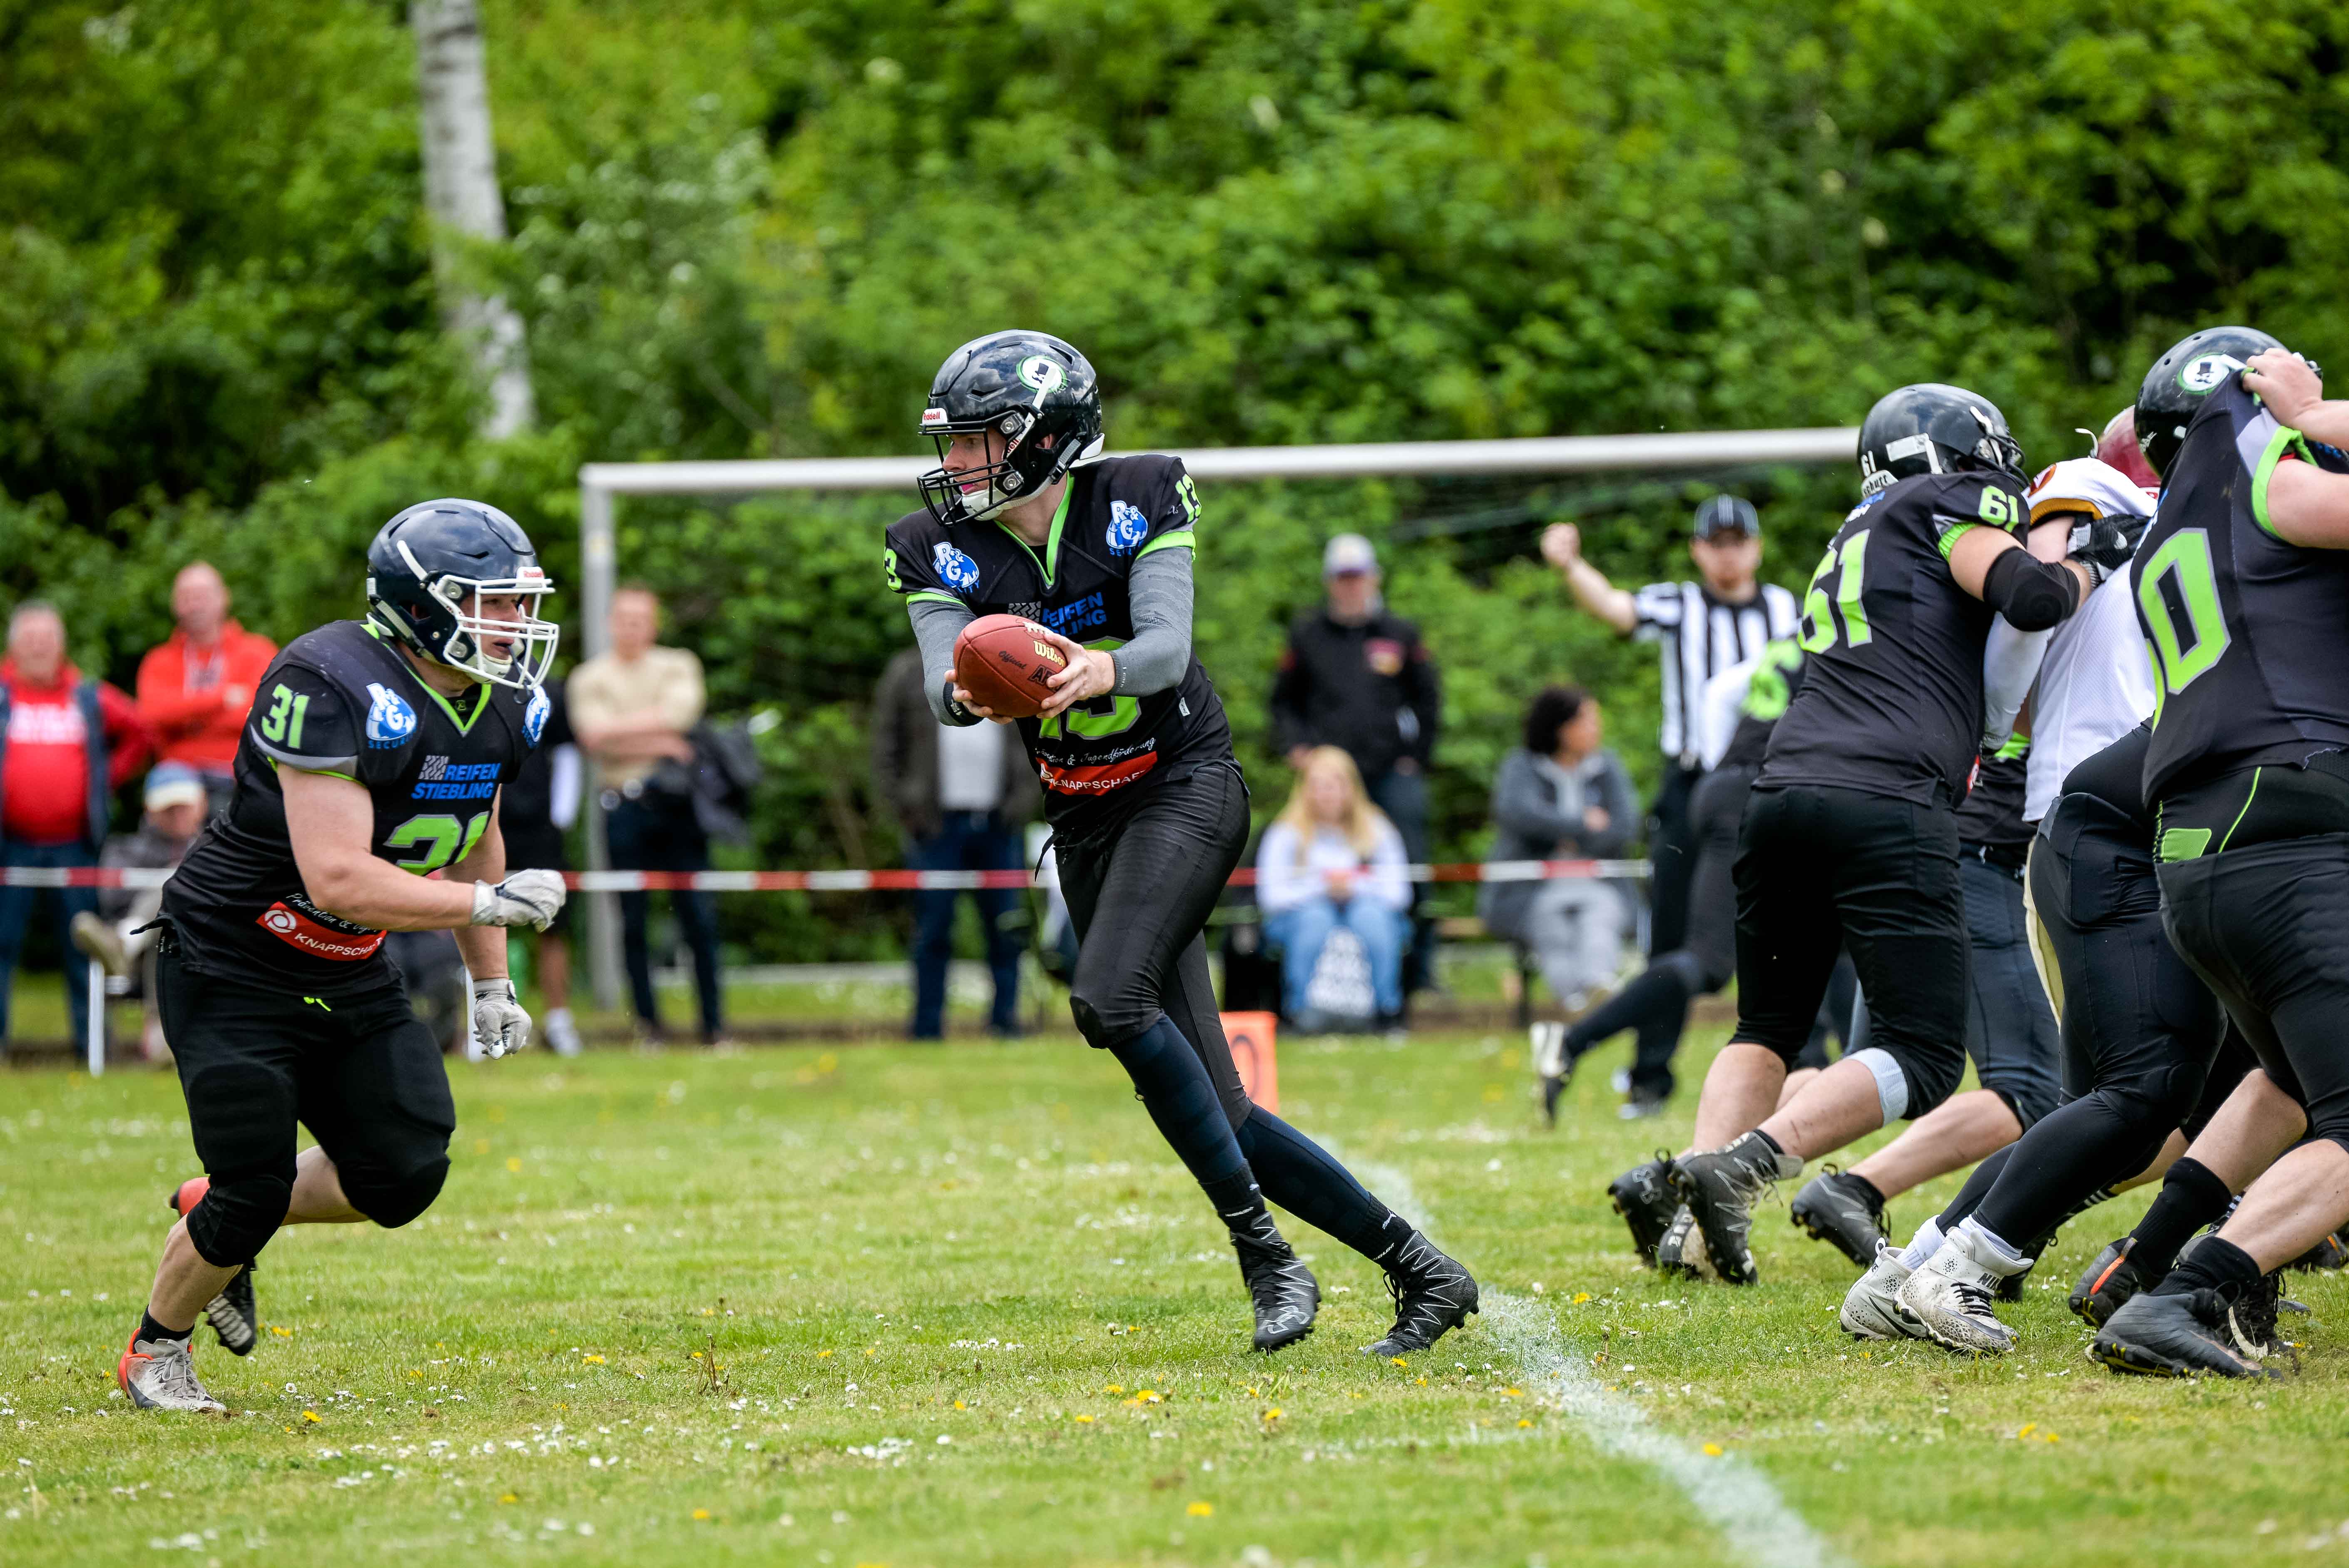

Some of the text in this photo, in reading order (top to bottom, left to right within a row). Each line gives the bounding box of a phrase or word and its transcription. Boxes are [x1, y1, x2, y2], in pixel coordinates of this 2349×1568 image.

[1978, 485, 2019, 533] 61
[883, 546, 902, 591] 3
[1797, 528, 1872, 654] 61
[2137, 528, 2232, 736] 0
[261, 683, 310, 749] 31
[1068, 754, 1076, 765] &
[1080, 737, 1156, 765] Jugendförderung
[443, 763, 501, 781] REIFEN
[411, 782, 494, 800] STIEBLING
[286, 893, 336, 923] Prävention
[1976, 1272, 2001, 1291] NIK
